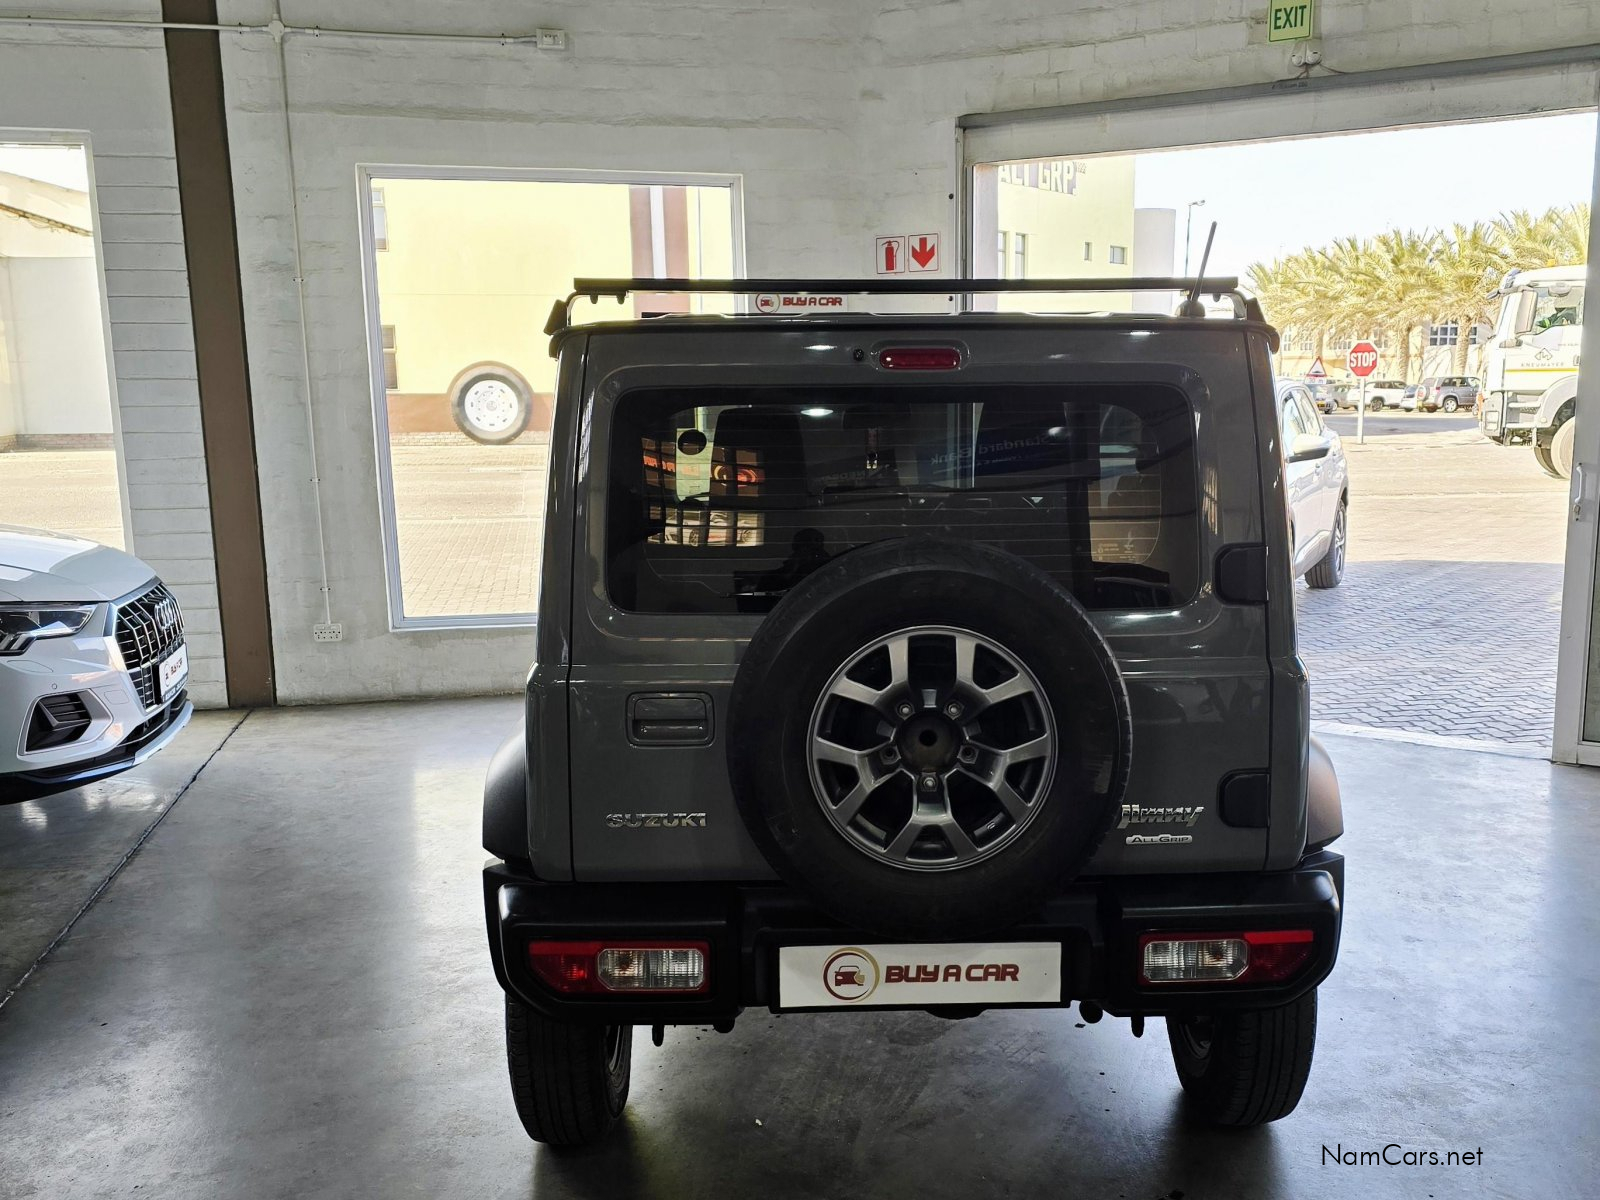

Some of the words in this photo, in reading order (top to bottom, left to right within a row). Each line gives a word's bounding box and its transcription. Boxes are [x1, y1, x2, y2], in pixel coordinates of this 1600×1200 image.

[1274, 5, 1307, 30] EXIT
[783, 296, 807, 306] BUY
[808, 296, 817, 306] A
[818, 296, 843, 306] CAR
[1350, 351, 1377, 368] STOP
[605, 812, 707, 829] SUZUKI
[885, 964, 940, 984] BUY
[942, 964, 962, 983] A
[965, 963, 1020, 983] CAR
